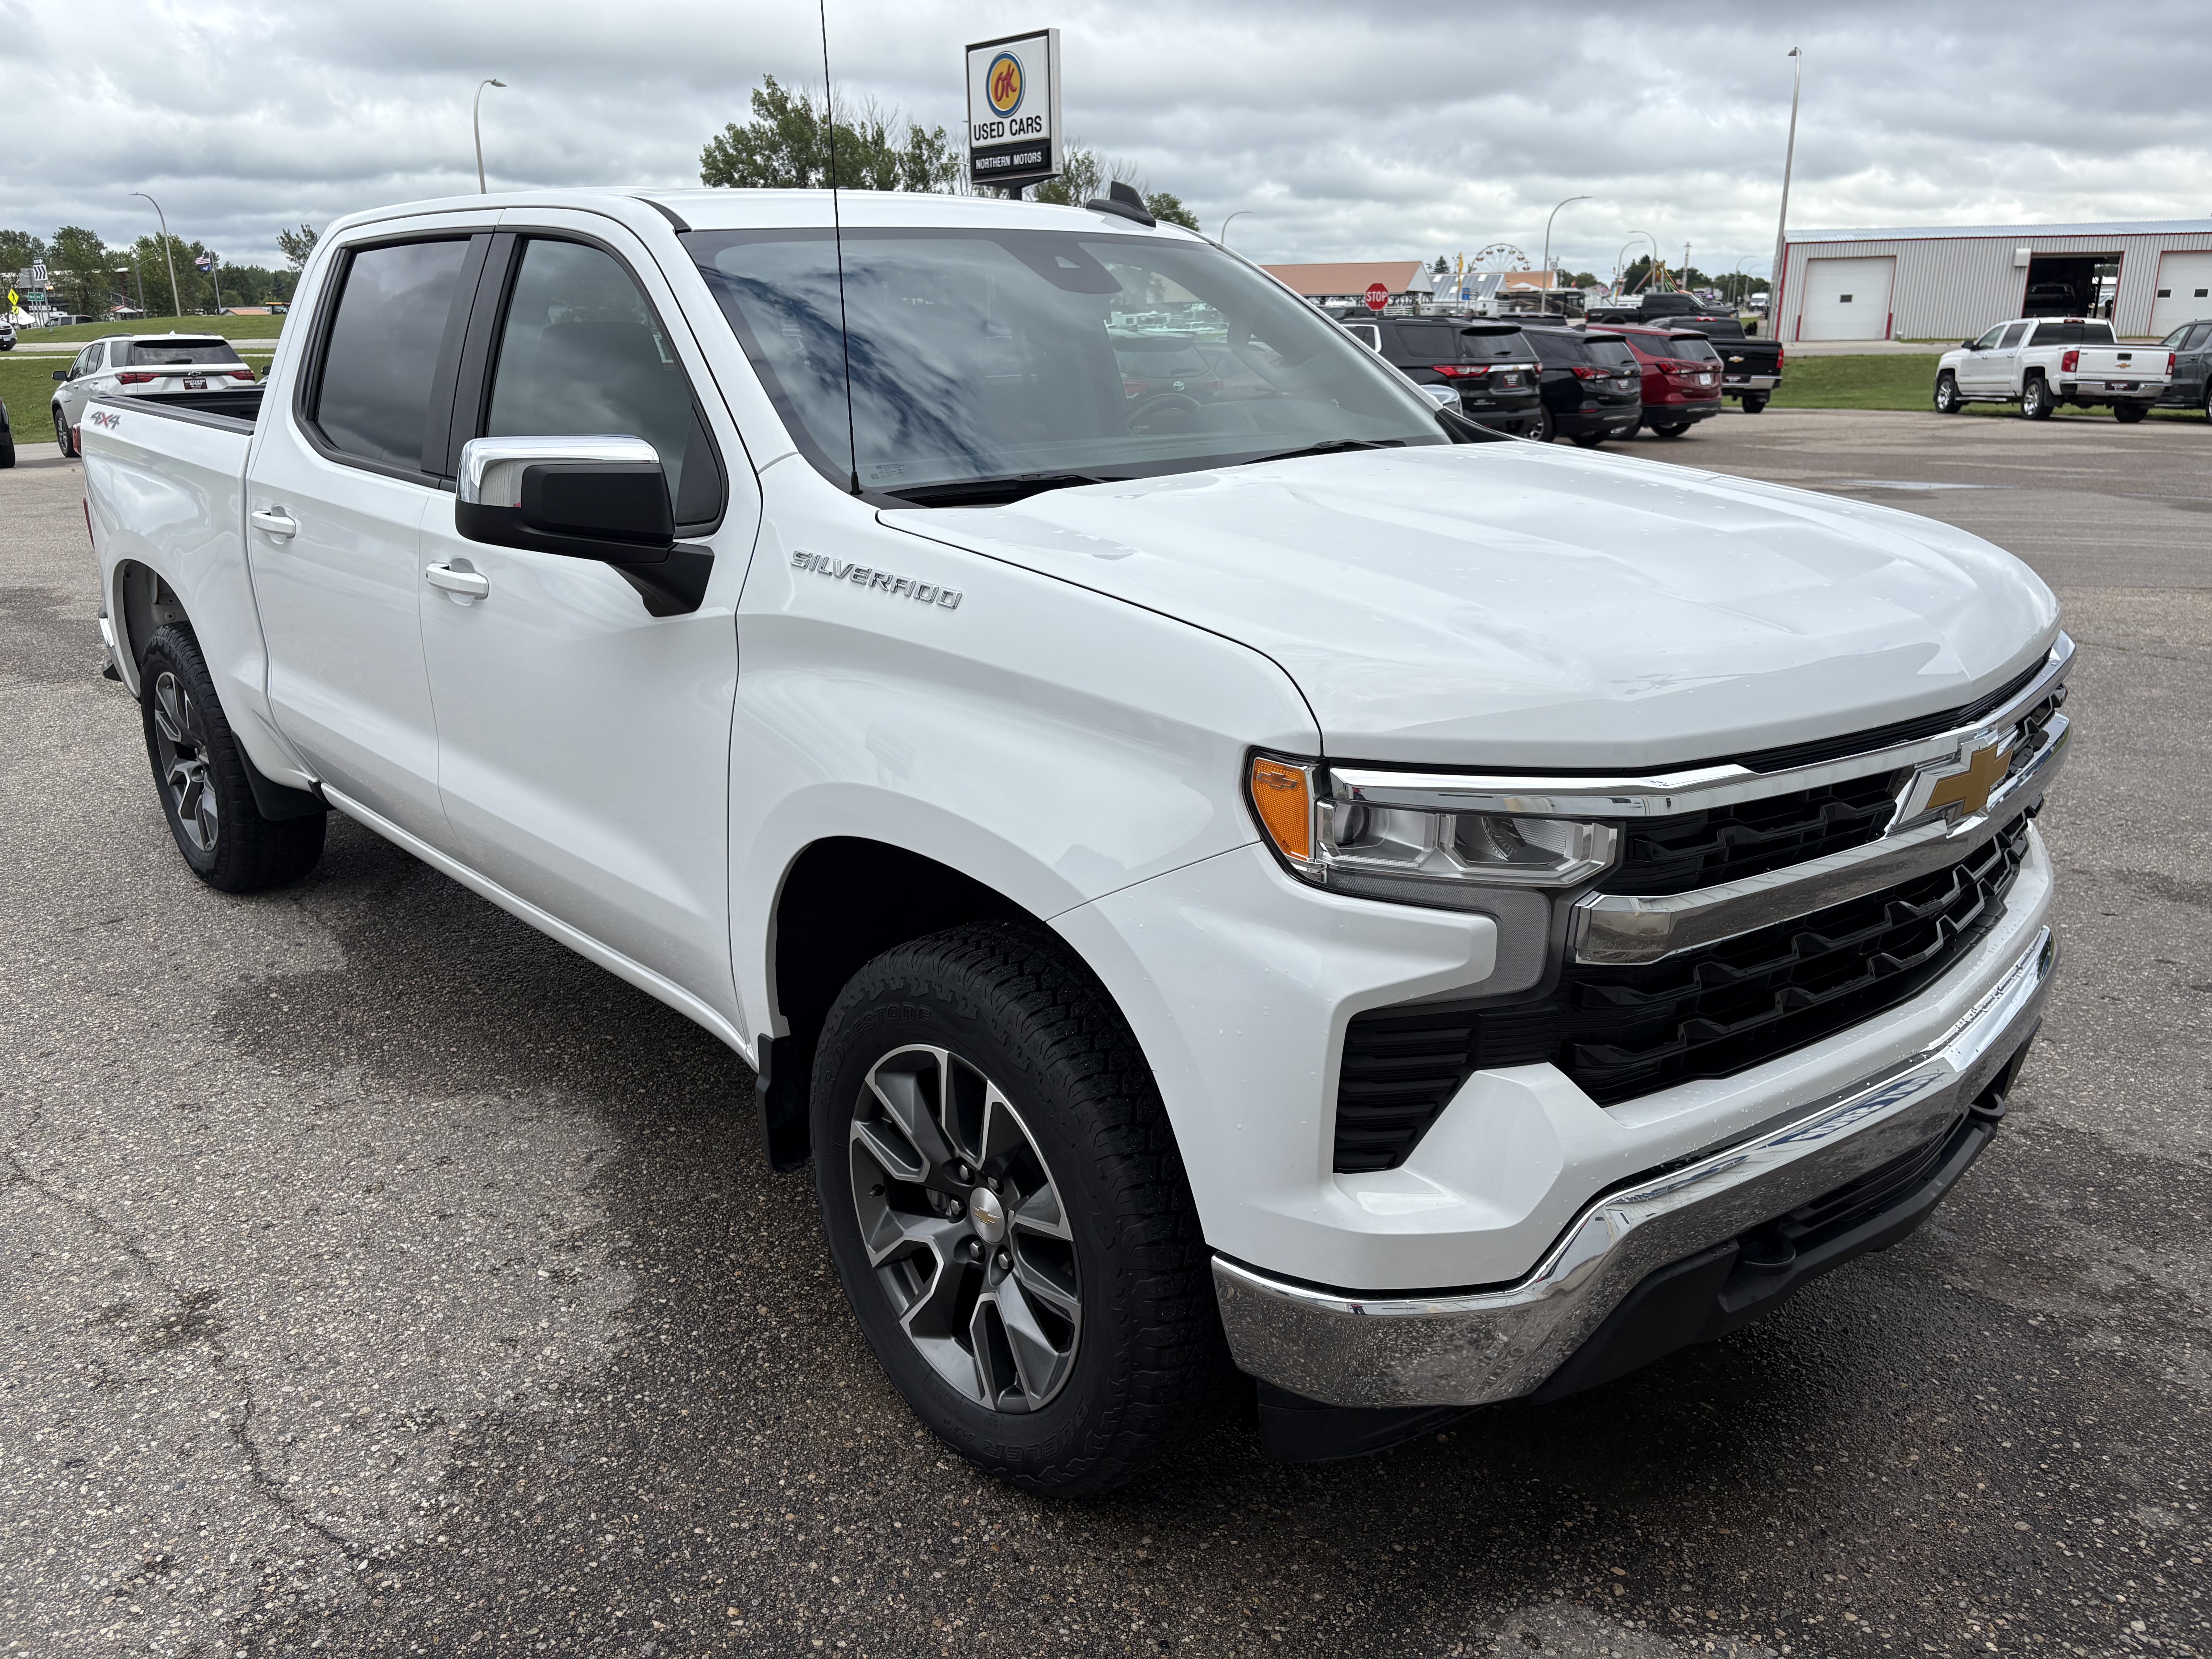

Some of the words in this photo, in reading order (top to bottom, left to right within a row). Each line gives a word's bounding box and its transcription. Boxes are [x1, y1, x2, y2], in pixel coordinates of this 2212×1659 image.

[994, 63, 1017, 102] OK
[974, 121, 1005, 141] USED
[1010, 115, 1042, 136] CARS
[975, 156, 1011, 170] NORTHERN
[1013, 151, 1042, 165] MOTORS
[1366, 291, 1388, 302] STOP
[790, 549, 963, 610] SILVERADO
